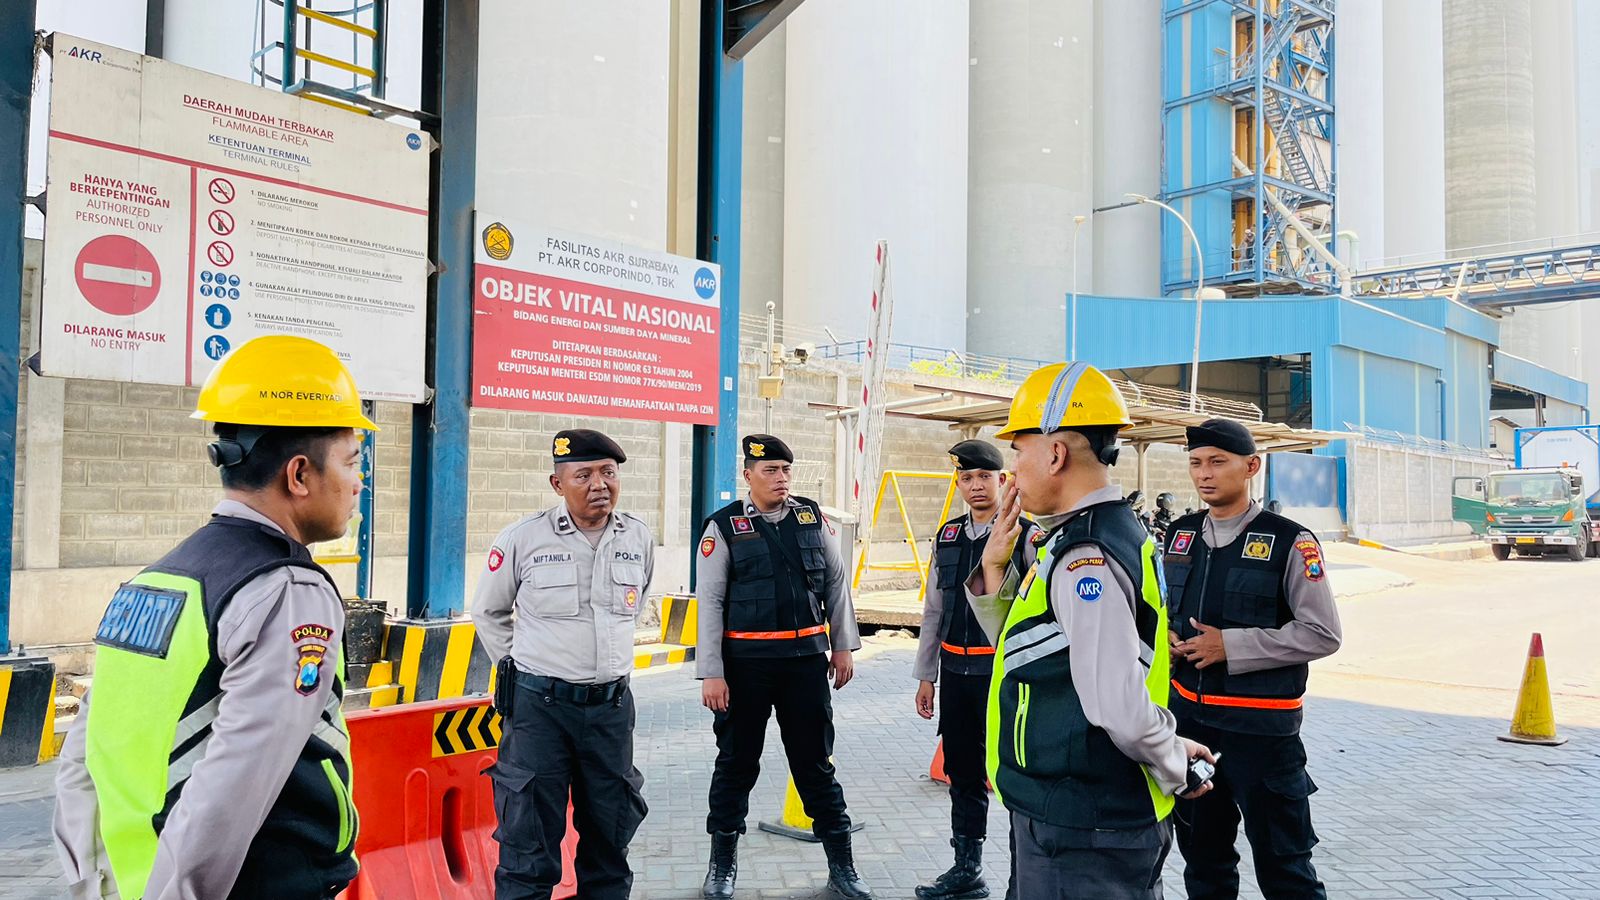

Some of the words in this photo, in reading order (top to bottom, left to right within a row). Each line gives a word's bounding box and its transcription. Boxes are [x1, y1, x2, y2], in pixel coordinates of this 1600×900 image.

[68, 46, 102, 63] AKR
[183, 94, 232, 114] DAERAH
[235, 107, 275, 125] MUDAH
[278, 118, 334, 140] TERBAKAR
[212, 116, 278, 140] FLAMMABLE
[280, 134, 309, 148] AREA
[208, 134, 265, 154] KETENTUAN
[268, 148, 312, 164] TERMINAL
[223, 149, 268, 166] TERMINAL
[270, 160, 300, 172] RULES
[70, 182, 170, 208] BERKEPENTINGAN
[84, 174, 124, 189] HANYA
[126, 181, 158, 196] YANG
[86, 198, 150, 218] AUTHORIZED
[257, 191, 288, 202] DILARANG
[290, 197, 319, 208] MEROKOK
[258, 200, 266, 208] NO
[267, 202, 293, 212] SMOKING
[76, 211, 135, 230] PERSONNEL
[138, 221, 164, 234] ONLY
[256, 220, 294, 233] MENITIPKAN
[296, 228, 314, 237] KOREK
[256, 230, 279, 240] DEPOSIT
[256, 252, 300, 264] NONAKTIFKAN
[547, 238, 600, 259] FASILITAS
[603, 251, 624, 264] AKR
[628, 255, 679, 275] SURABAYA
[538, 252, 555, 265] PT.
[557, 256, 580, 270] AKR
[584, 260, 654, 286] CORPORINDO,
[657, 275, 675, 289] TBK
[255, 282, 286, 292] GUNAKAN
[302, 288, 334, 298] PELINDUNG
[695, 276, 716, 290] AKR
[481, 277, 552, 308] OBJEK
[559, 289, 618, 319] VITAL
[623, 301, 716, 334] NASIONAL
[254, 312, 284, 322] KENAKAN
[285, 316, 305, 324] TANDA
[306, 318, 335, 328] PENGENAL
[514, 310, 549, 324] BIDANG
[551, 315, 582, 328] ENERGI
[583, 320, 602, 332] DAN
[604, 324, 636, 336] SUMBER
[636, 329, 659, 340] DAYA
[660, 332, 692, 344] MINERAL
[64, 324, 123, 338] DILARANG
[126, 330, 166, 342] MASUK
[90, 338, 106, 348] NO
[110, 340, 141, 350] ENTRY
[552, 340, 602, 356] DITETAPKAN
[603, 346, 658, 362] BERDASARKAN
[498, 361, 550, 376] KEPUTUSAN
[552, 367, 588, 380] MENTERI
[588, 372, 611, 382] ESDM
[612, 374, 642, 386] NOMOR
[511, 348, 561, 364] KEPUTUSAN
[563, 355, 602, 368] PRESIDEN
[603, 360, 612, 370] RI
[613, 361, 642, 374] NOMOR
[642, 365, 652, 374] 63
[652, 366, 676, 378] TAHUN
[677, 369, 694, 380] 2004
[260, 390, 268, 398] M
[271, 391, 294, 399] NOR
[480, 385, 530, 400] DILARANG
[532, 390, 565, 402] MASUK
[566, 392, 609, 406] DAN/ATAU
[610, 396, 675, 412] MEMANFAATKAN
[676, 402, 699, 414] TANPA
[700, 405, 714, 416] IZIN
[614, 552, 642, 561] POLRI
[1080, 582, 1100, 596] AKR
[97, 590, 182, 650] SECURITY
[294, 626, 329, 640] POLDA
